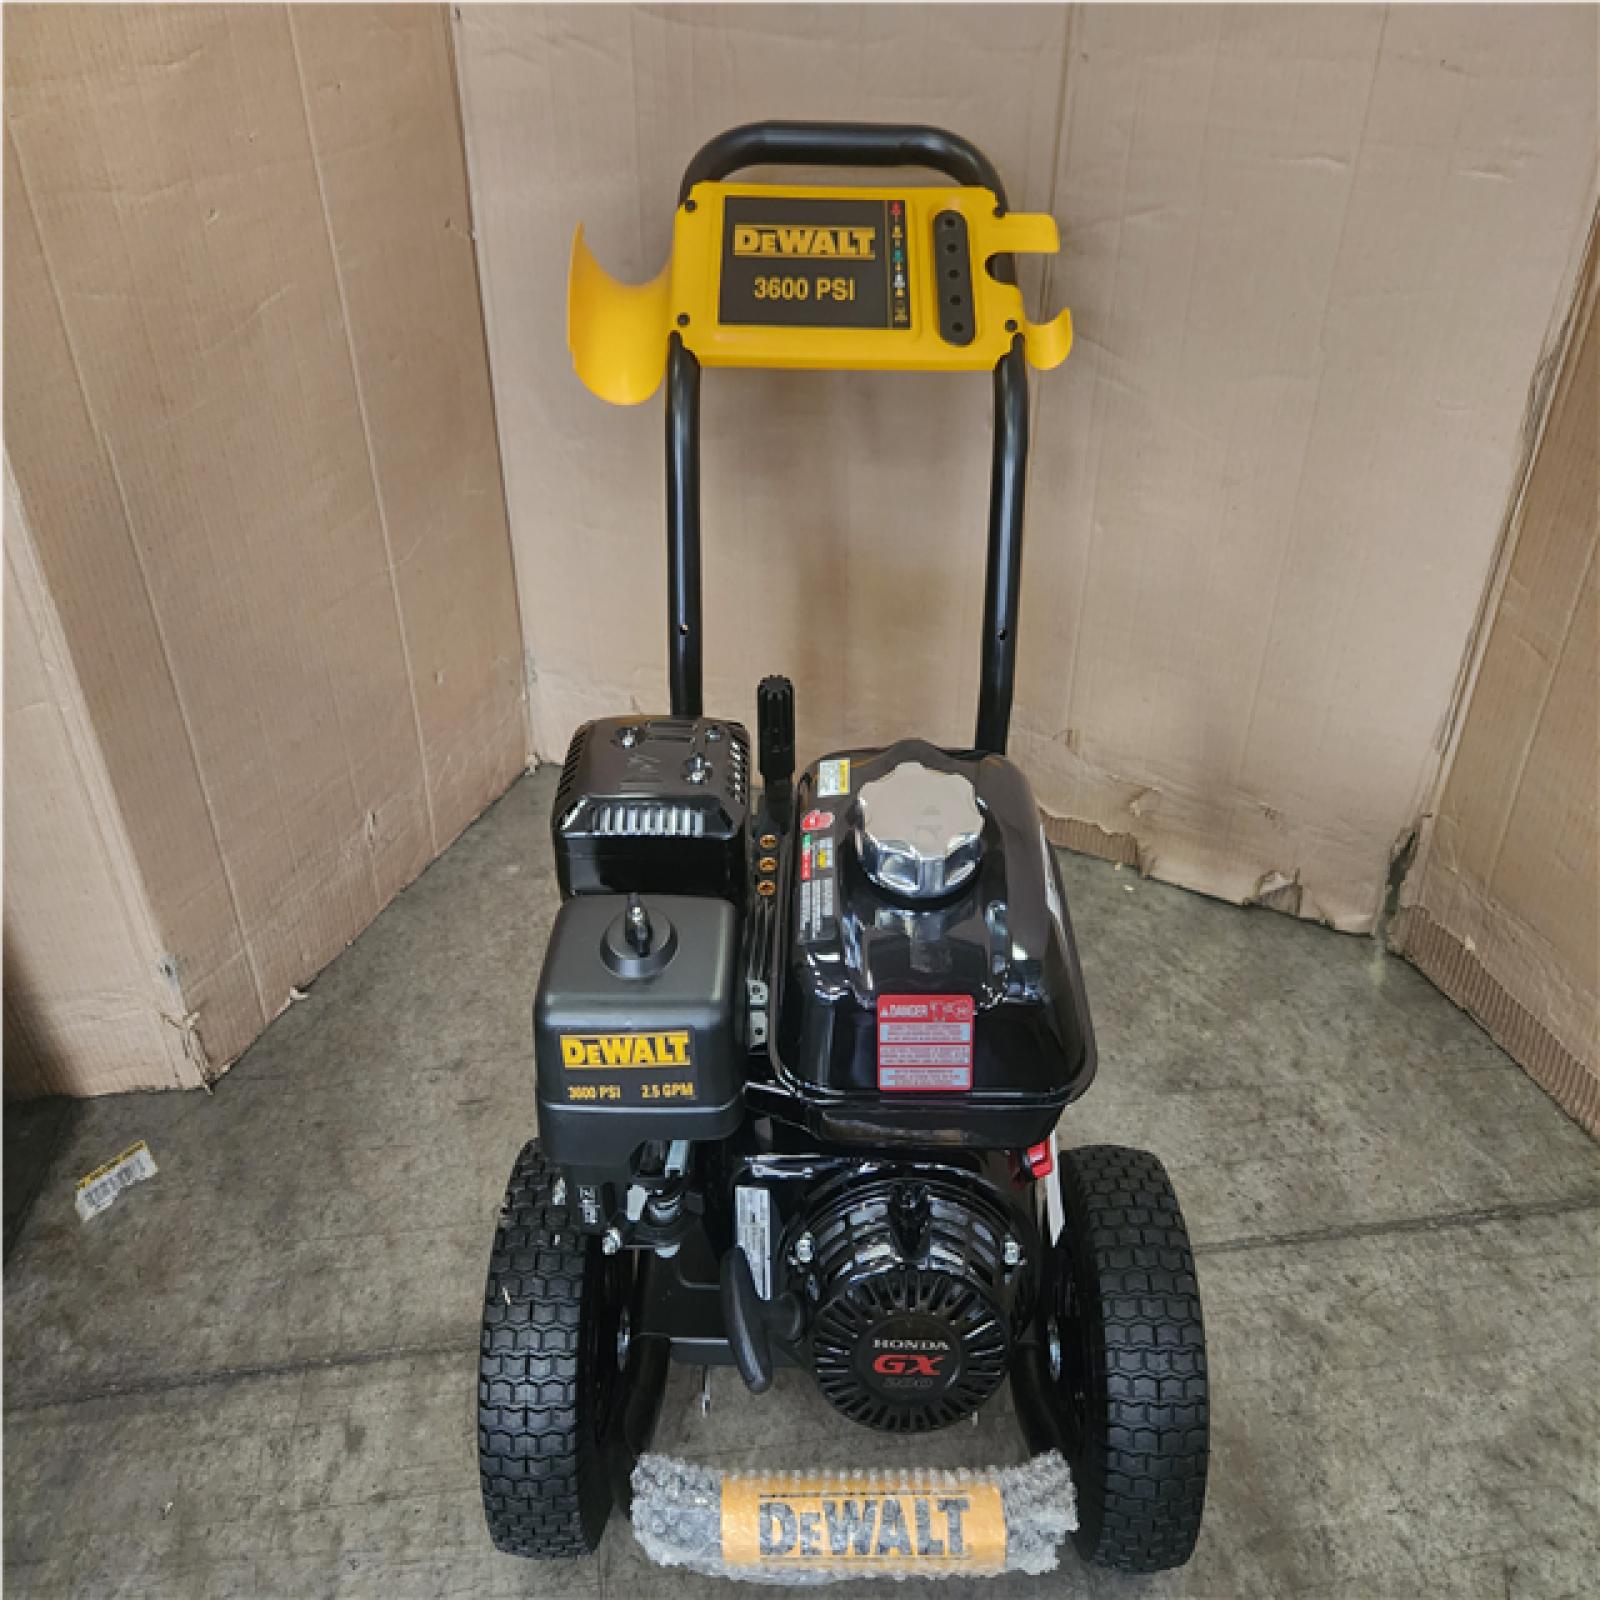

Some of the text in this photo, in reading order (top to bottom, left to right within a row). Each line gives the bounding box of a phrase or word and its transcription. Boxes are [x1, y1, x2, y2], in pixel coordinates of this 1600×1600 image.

[753, 276, 856, 302] 3600 PSI
[599, 1084, 621, 1100] PSI
[662, 1082, 693, 1098] GPM
[872, 1339, 950, 1351] HONDA
[872, 1354, 943, 1376] GX
